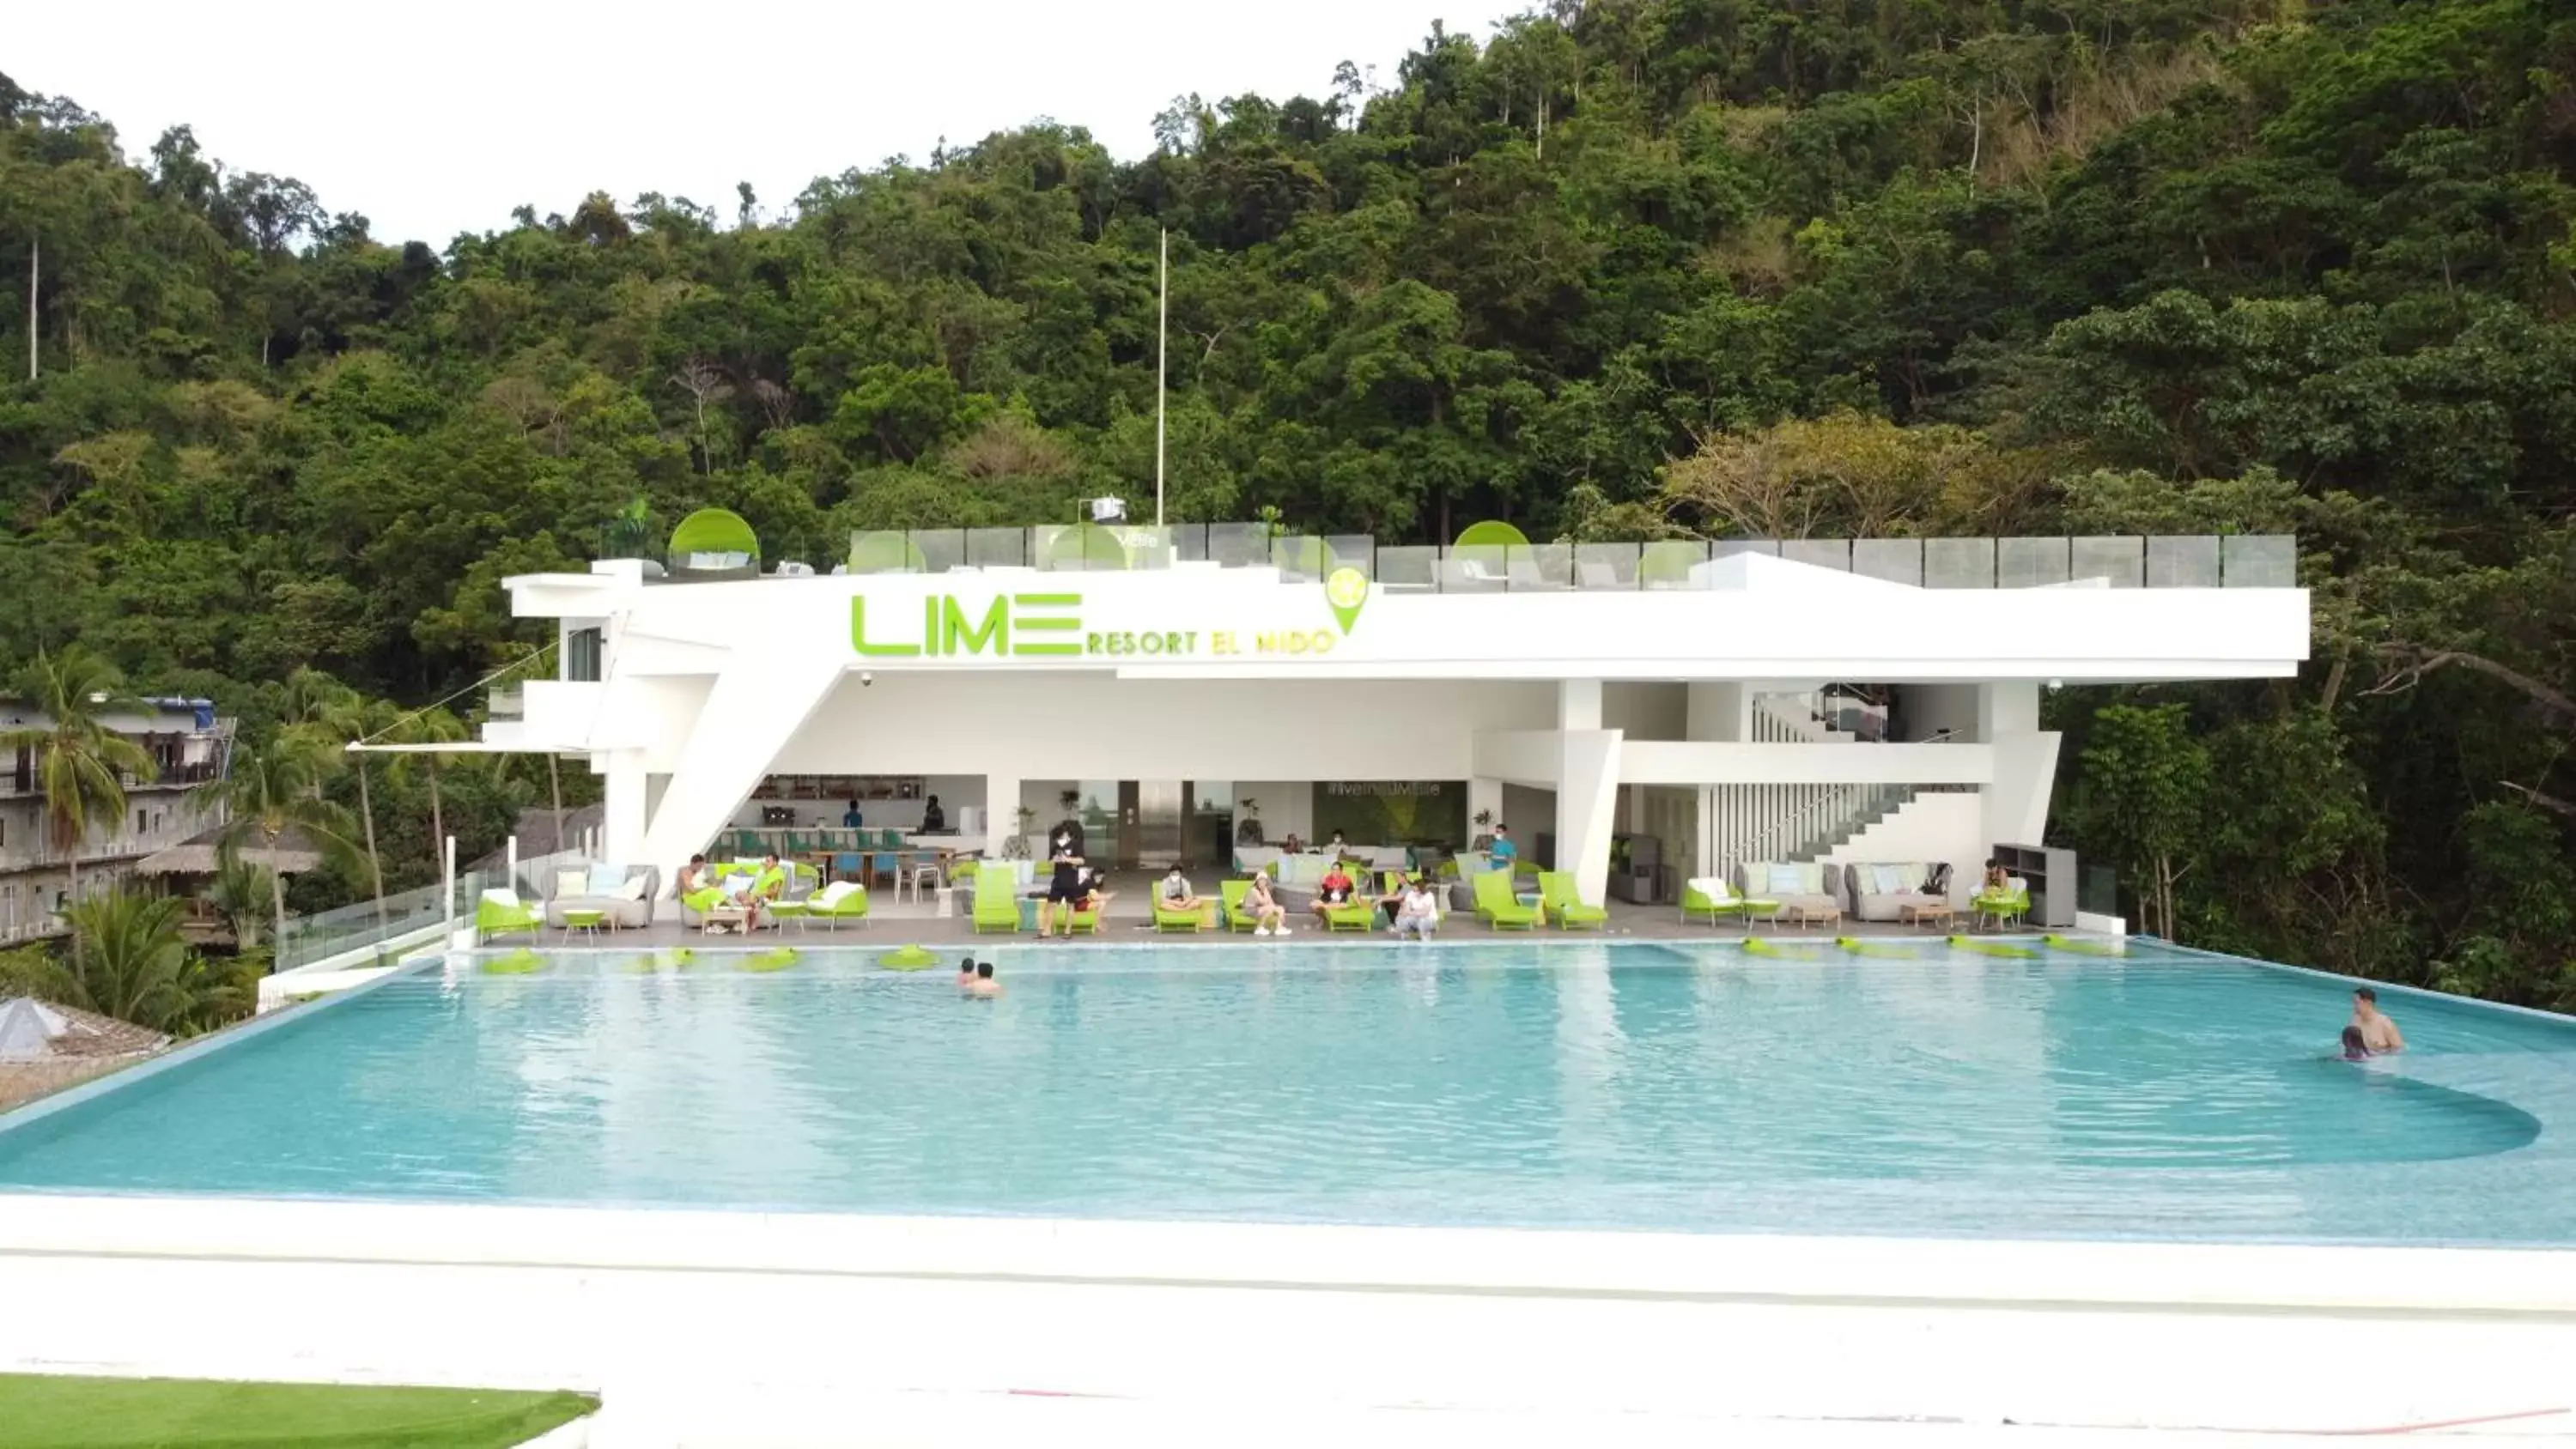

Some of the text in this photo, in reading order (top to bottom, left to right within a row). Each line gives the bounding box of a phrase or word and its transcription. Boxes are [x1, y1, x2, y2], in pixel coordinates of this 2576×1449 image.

[851, 593, 1336, 656] LIME RESORT EL NIDO
